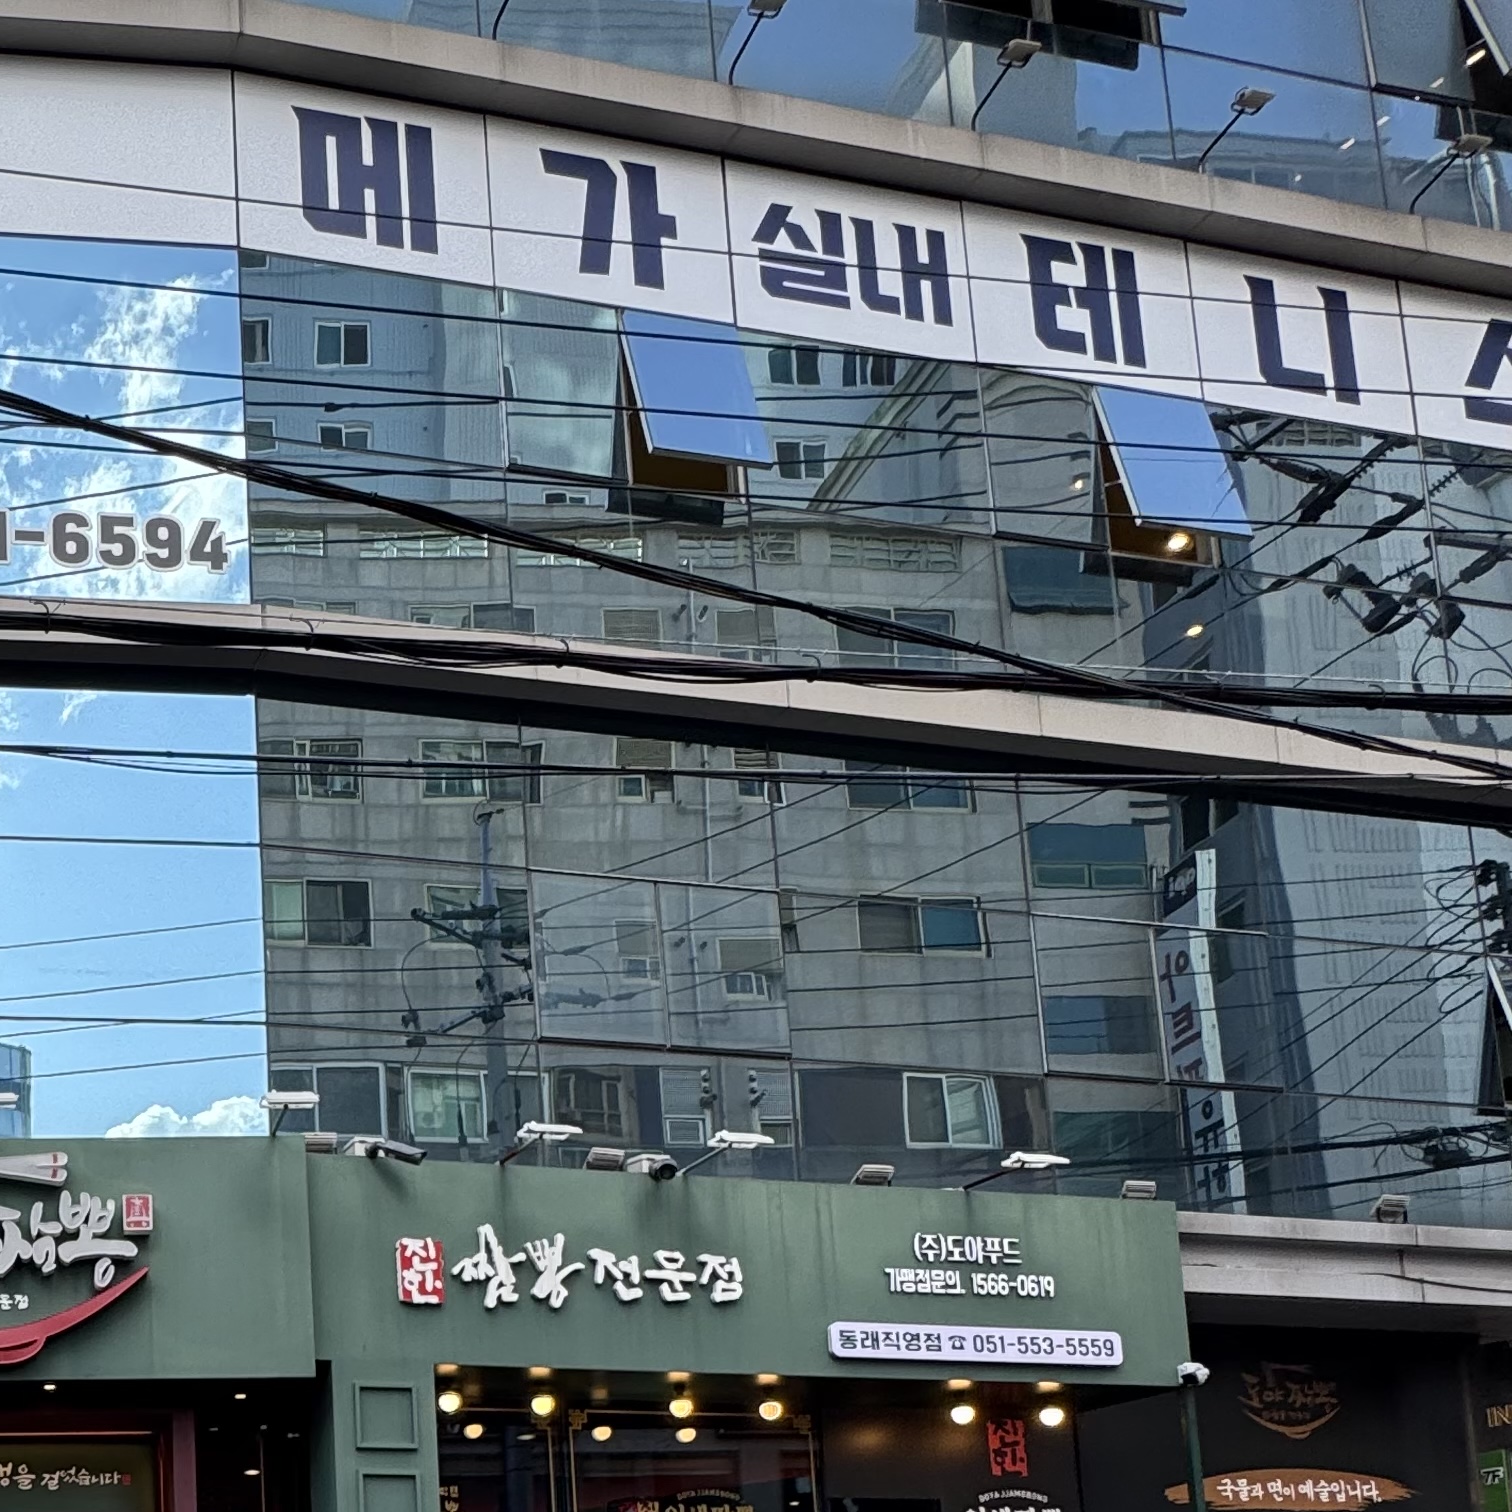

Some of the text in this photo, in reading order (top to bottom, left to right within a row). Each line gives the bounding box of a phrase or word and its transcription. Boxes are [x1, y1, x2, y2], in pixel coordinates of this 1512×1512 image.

[397, 1223, 744, 1309] 진한 짬뽕 전문점
[971, 1271, 1056, 1298] 1566-0619
[838, 1328, 1115, 1358] 동래직영점 051-553-5559
[40, 1466, 122, 1491] 걸었습니다
[1481, 1468, 1504, 1486] 7F
[1215, 1478, 1383, 1504] 국물과 면이 예술입니다.
